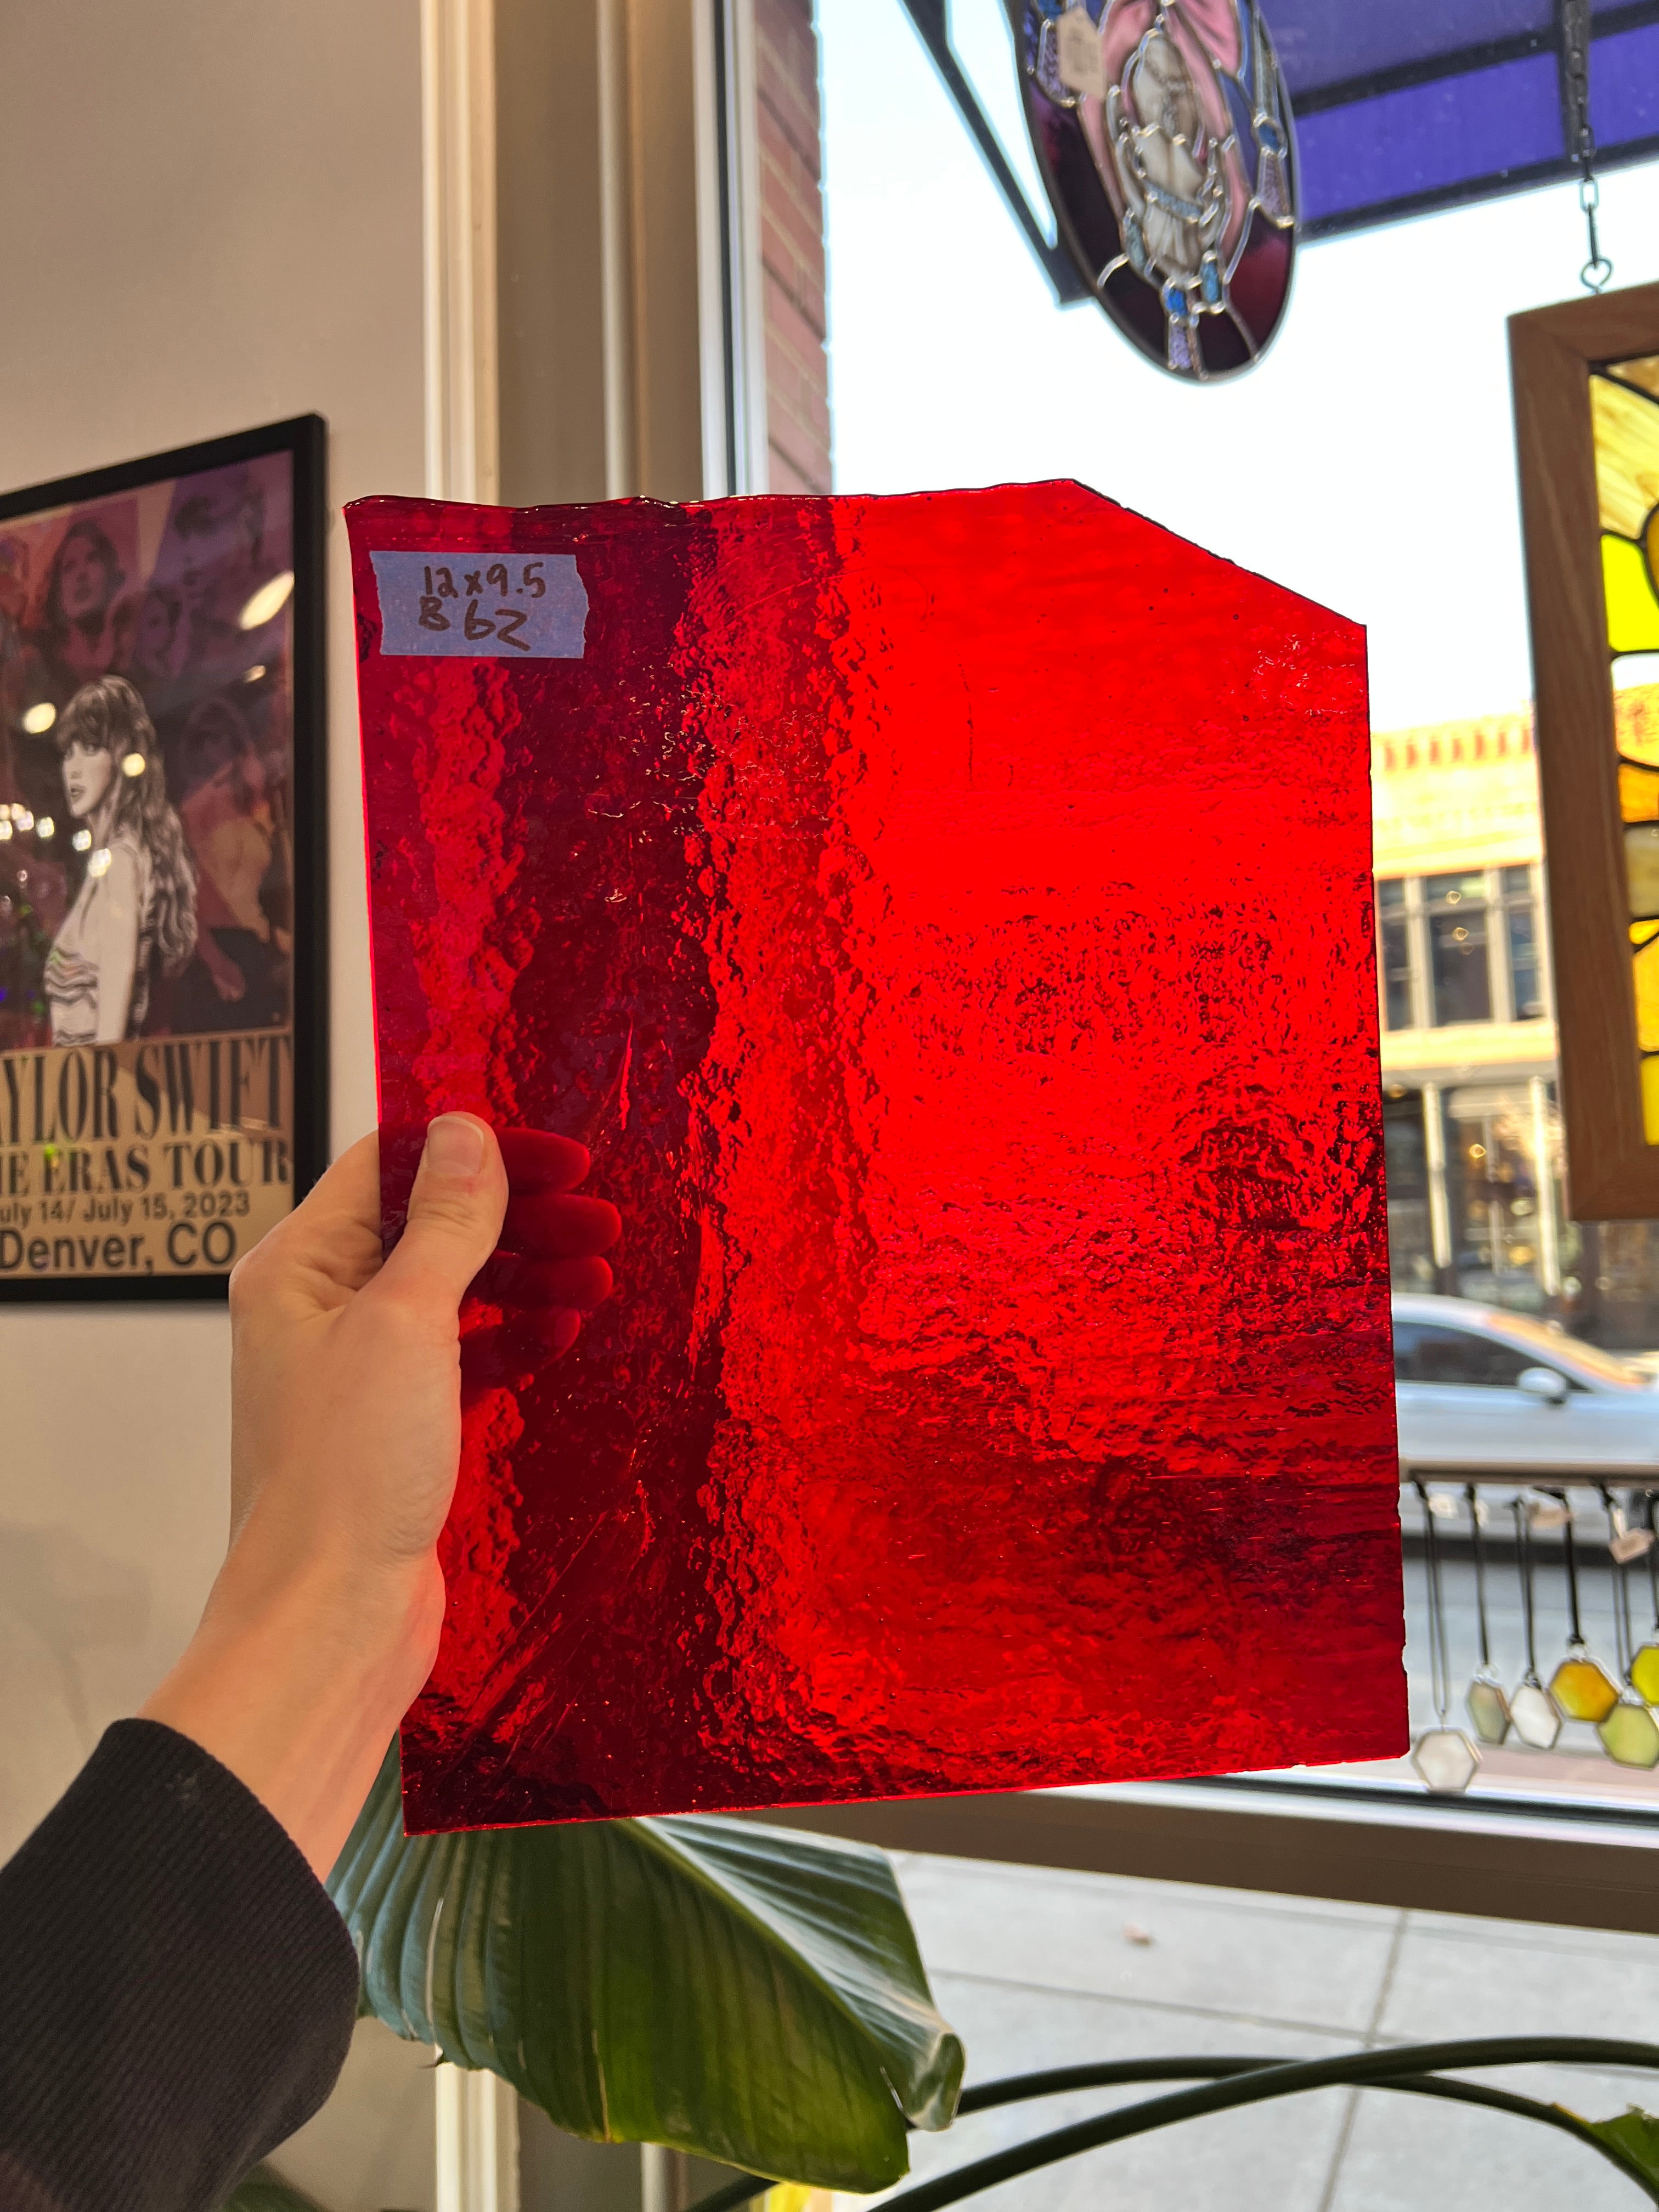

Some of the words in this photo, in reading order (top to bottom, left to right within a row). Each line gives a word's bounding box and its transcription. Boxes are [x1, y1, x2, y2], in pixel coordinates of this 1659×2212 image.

[464, 599, 531, 652] 62
[0, 1048, 120, 1146] YLOR
[134, 1035, 293, 1140] SWIFT
[0, 1150, 30, 1197] E
[42, 1143, 151, 1196] ERAS
[163, 1138, 292, 1189] TOUR
[0, 1201, 32, 1231] uly
[83, 1198, 133, 1227] July
[183, 1189, 250, 1217] 2023
[0, 1227, 154, 1275] Denver,
[167, 1220, 237, 1267] CO
